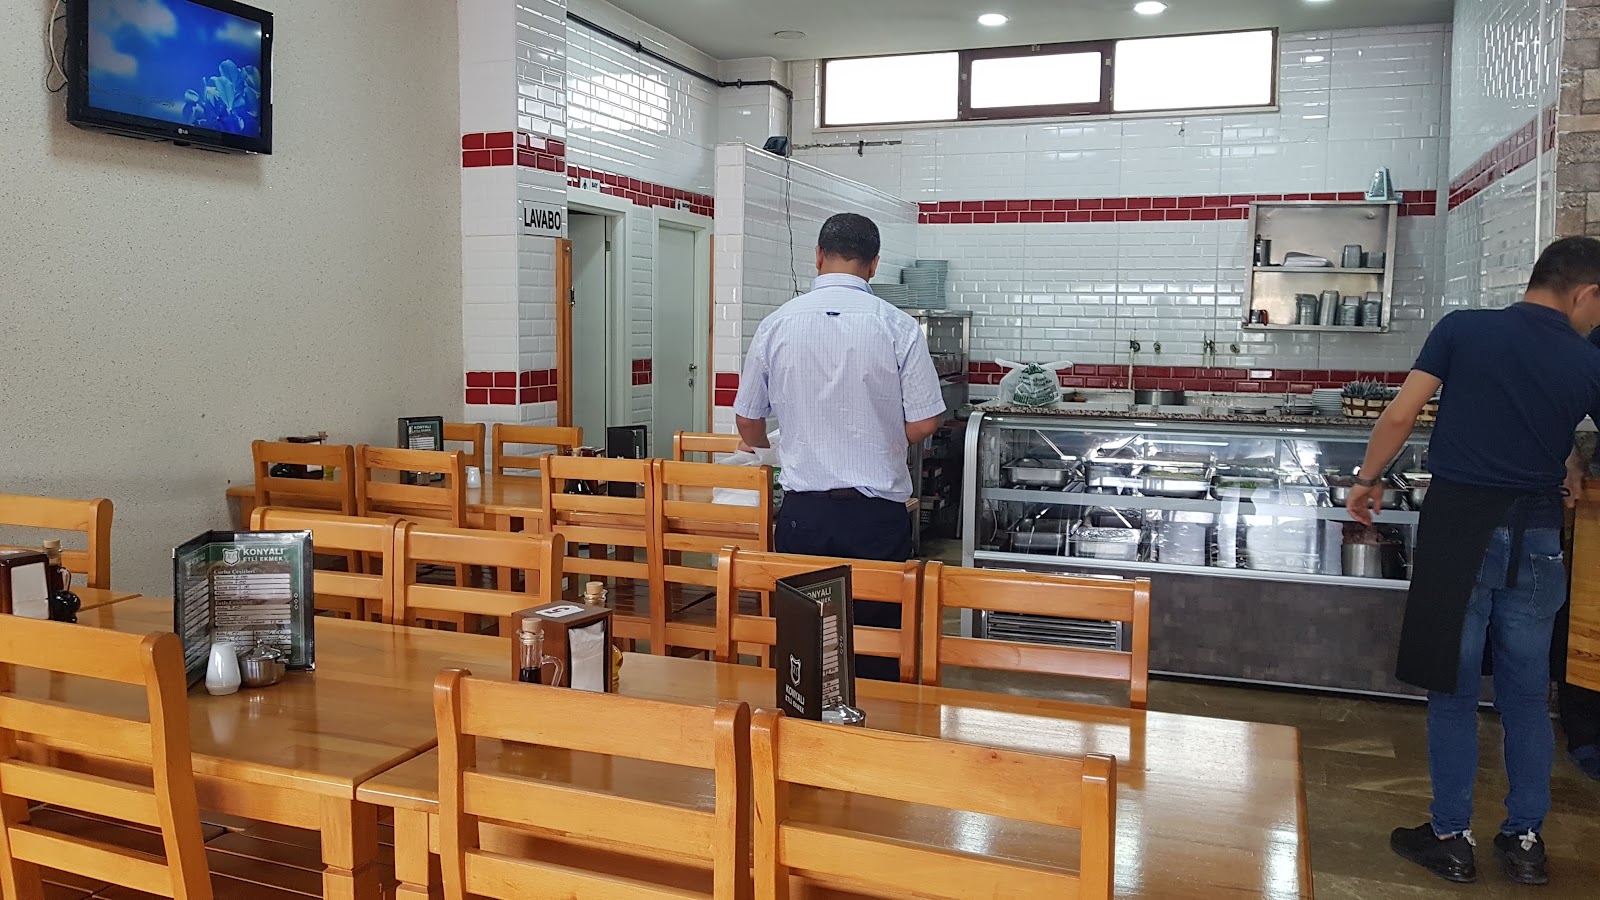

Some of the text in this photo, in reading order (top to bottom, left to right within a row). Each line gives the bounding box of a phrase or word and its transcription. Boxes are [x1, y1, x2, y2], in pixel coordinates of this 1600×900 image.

[523, 207, 562, 231] LAVABO
[243, 548, 284, 556] KONYALI
[805, 587, 832, 600] ONYALI
